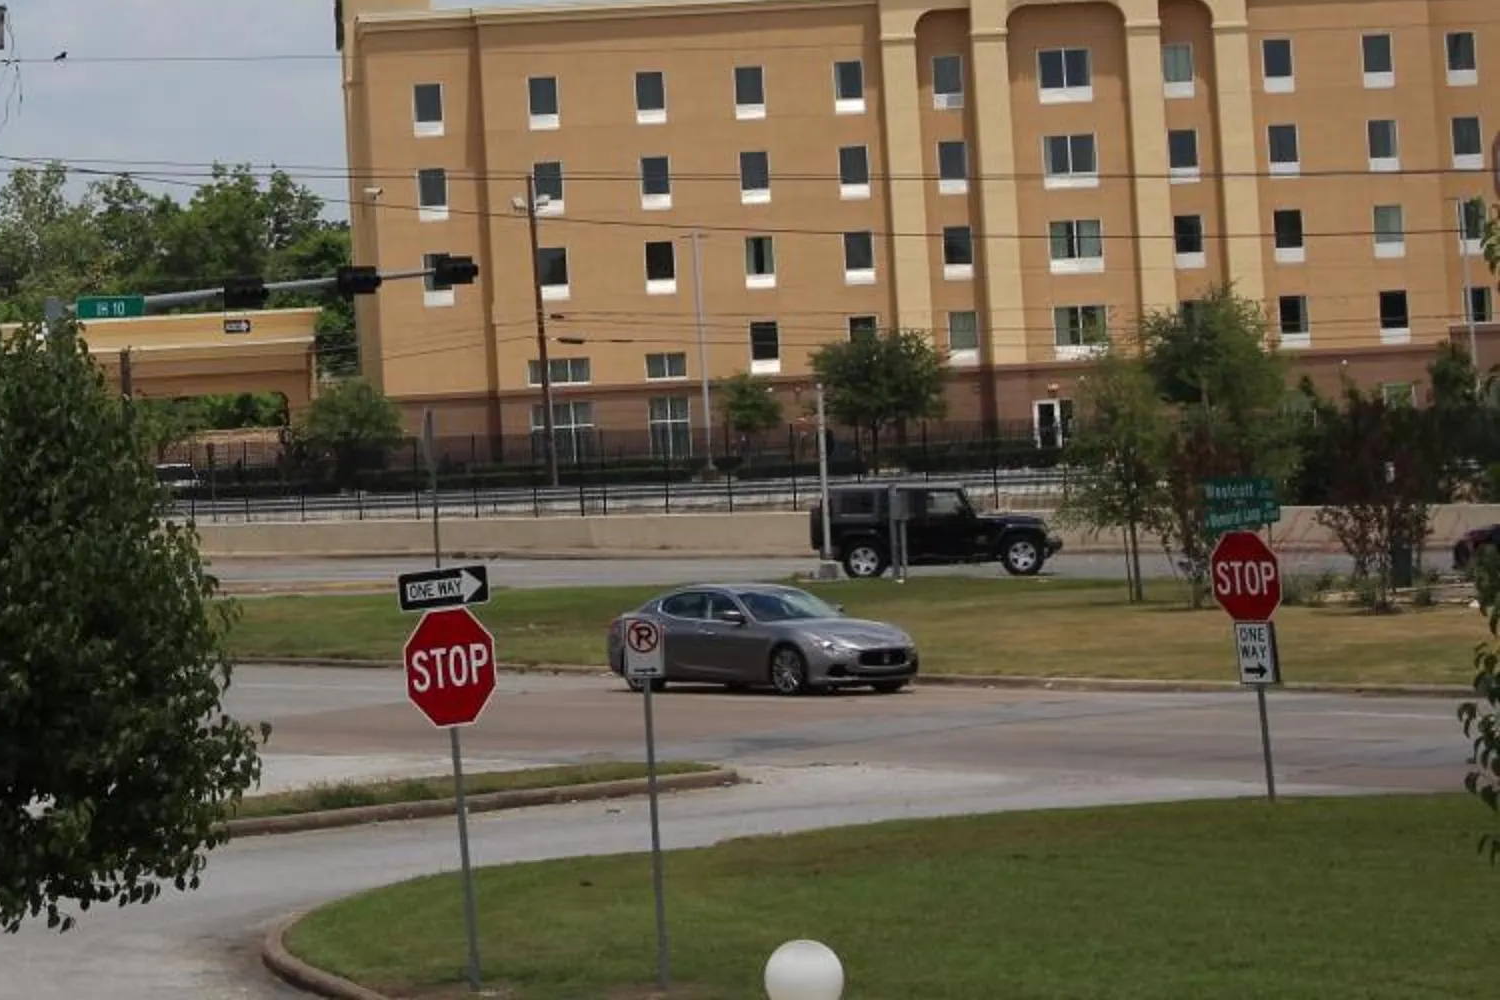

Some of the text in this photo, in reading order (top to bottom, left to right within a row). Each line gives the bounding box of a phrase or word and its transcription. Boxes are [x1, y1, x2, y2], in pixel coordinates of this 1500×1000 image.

[112, 301, 125, 315] 10
[1216, 560, 1275, 596] STOP
[409, 579, 462, 599] ONE WAY
[1239, 627, 1265, 643] ONE
[1240, 645, 1267, 660] WAY
[411, 643, 489, 693] STOP
